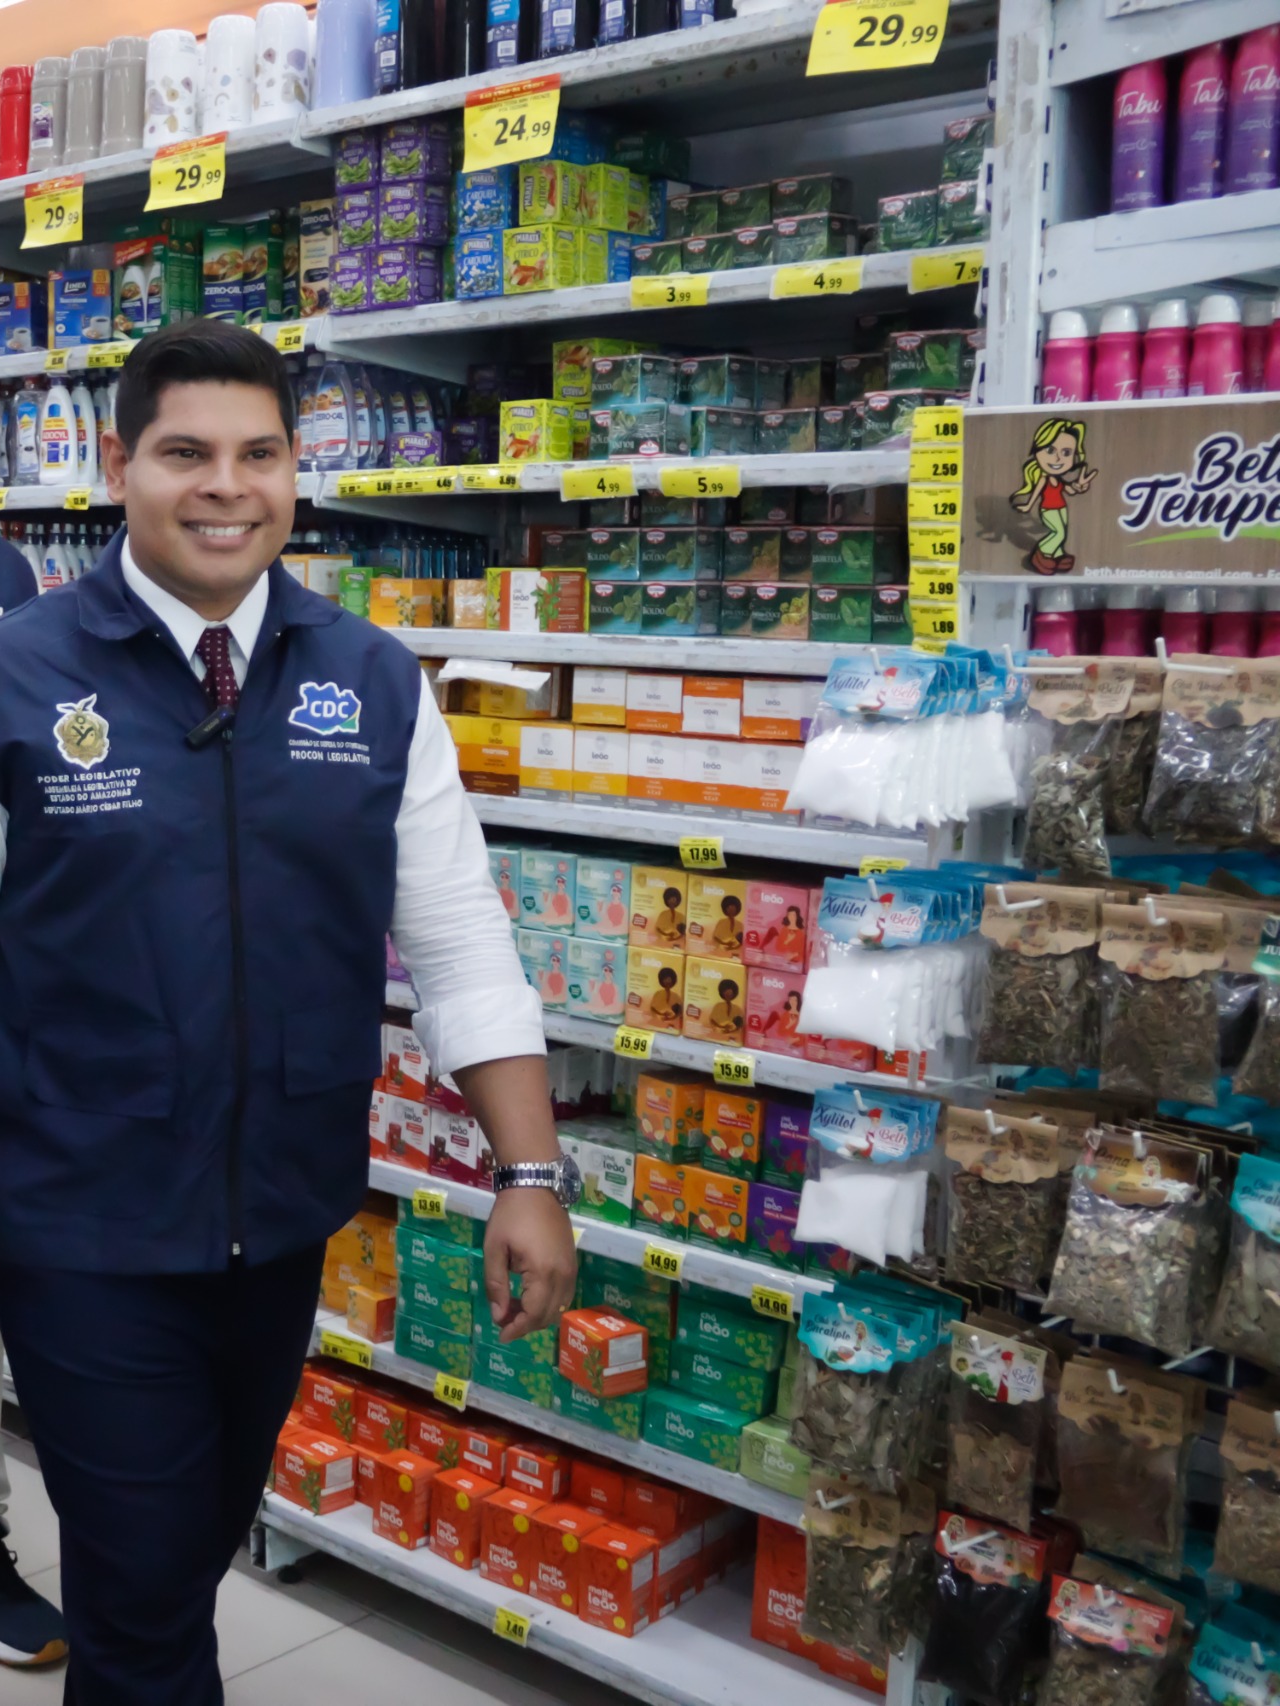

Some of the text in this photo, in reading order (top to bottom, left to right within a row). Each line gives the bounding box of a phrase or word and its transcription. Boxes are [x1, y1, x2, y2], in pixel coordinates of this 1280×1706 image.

[853, 13, 939, 48] 29,99
[1116, 90, 1162, 120] Tabu
[494, 113, 551, 146] 24,99
[175, 163, 222, 193] 29,99
[43, 204, 80, 231] 29,99
[813, 272, 843, 290] 4,99
[665, 286, 692, 303] 3,99
[596, 477, 620, 494] 4,99
[697, 476, 724, 494] 5,99
[1122, 477, 1280, 538] Tempe
[309, 700, 350, 719] CDC
[290, 750, 371, 765] PROCON LEGISLATIVO
[37, 767, 141, 784] PODER LEGISLATIVO
[90, 788, 132, 800] AMAZONAS
[760, 893, 784, 905] leão
[821, 896, 867, 918] Xylitol
[762, 976, 785, 990] leão
[813, 1105, 856, 1131] Xylitol
[878, 1127, 908, 1146] Beth
[603, 1160, 625, 1174] leão
[411, 1245, 435, 1262] leão
[414, 1288, 438, 1307] leão
[603, 1290, 632, 1310] leão
[699, 1319, 730, 1338] leão
[410, 1330, 435, 1348] leão
[568, 1336, 588, 1355] leão
[488, 1358, 515, 1378] leão
[692, 1361, 722, 1381] leão
[313, 1391, 337, 1408] leão
[367, 1408, 391, 1426] leão
[420, 1428, 445, 1447] leão
[665, 1419, 695, 1440] leão
[285, 1459, 307, 1477] leão
[763, 1450, 796, 1473] leão
[380, 1508, 403, 1528] leão
[436, 1526, 459, 1546] leão
[489, 1549, 518, 1570] leão
[538, 1569, 567, 1590] leão
[588, 1584, 614, 1600] matte
[768, 1588, 804, 1608] matte
[587, 1592, 618, 1613] leão
